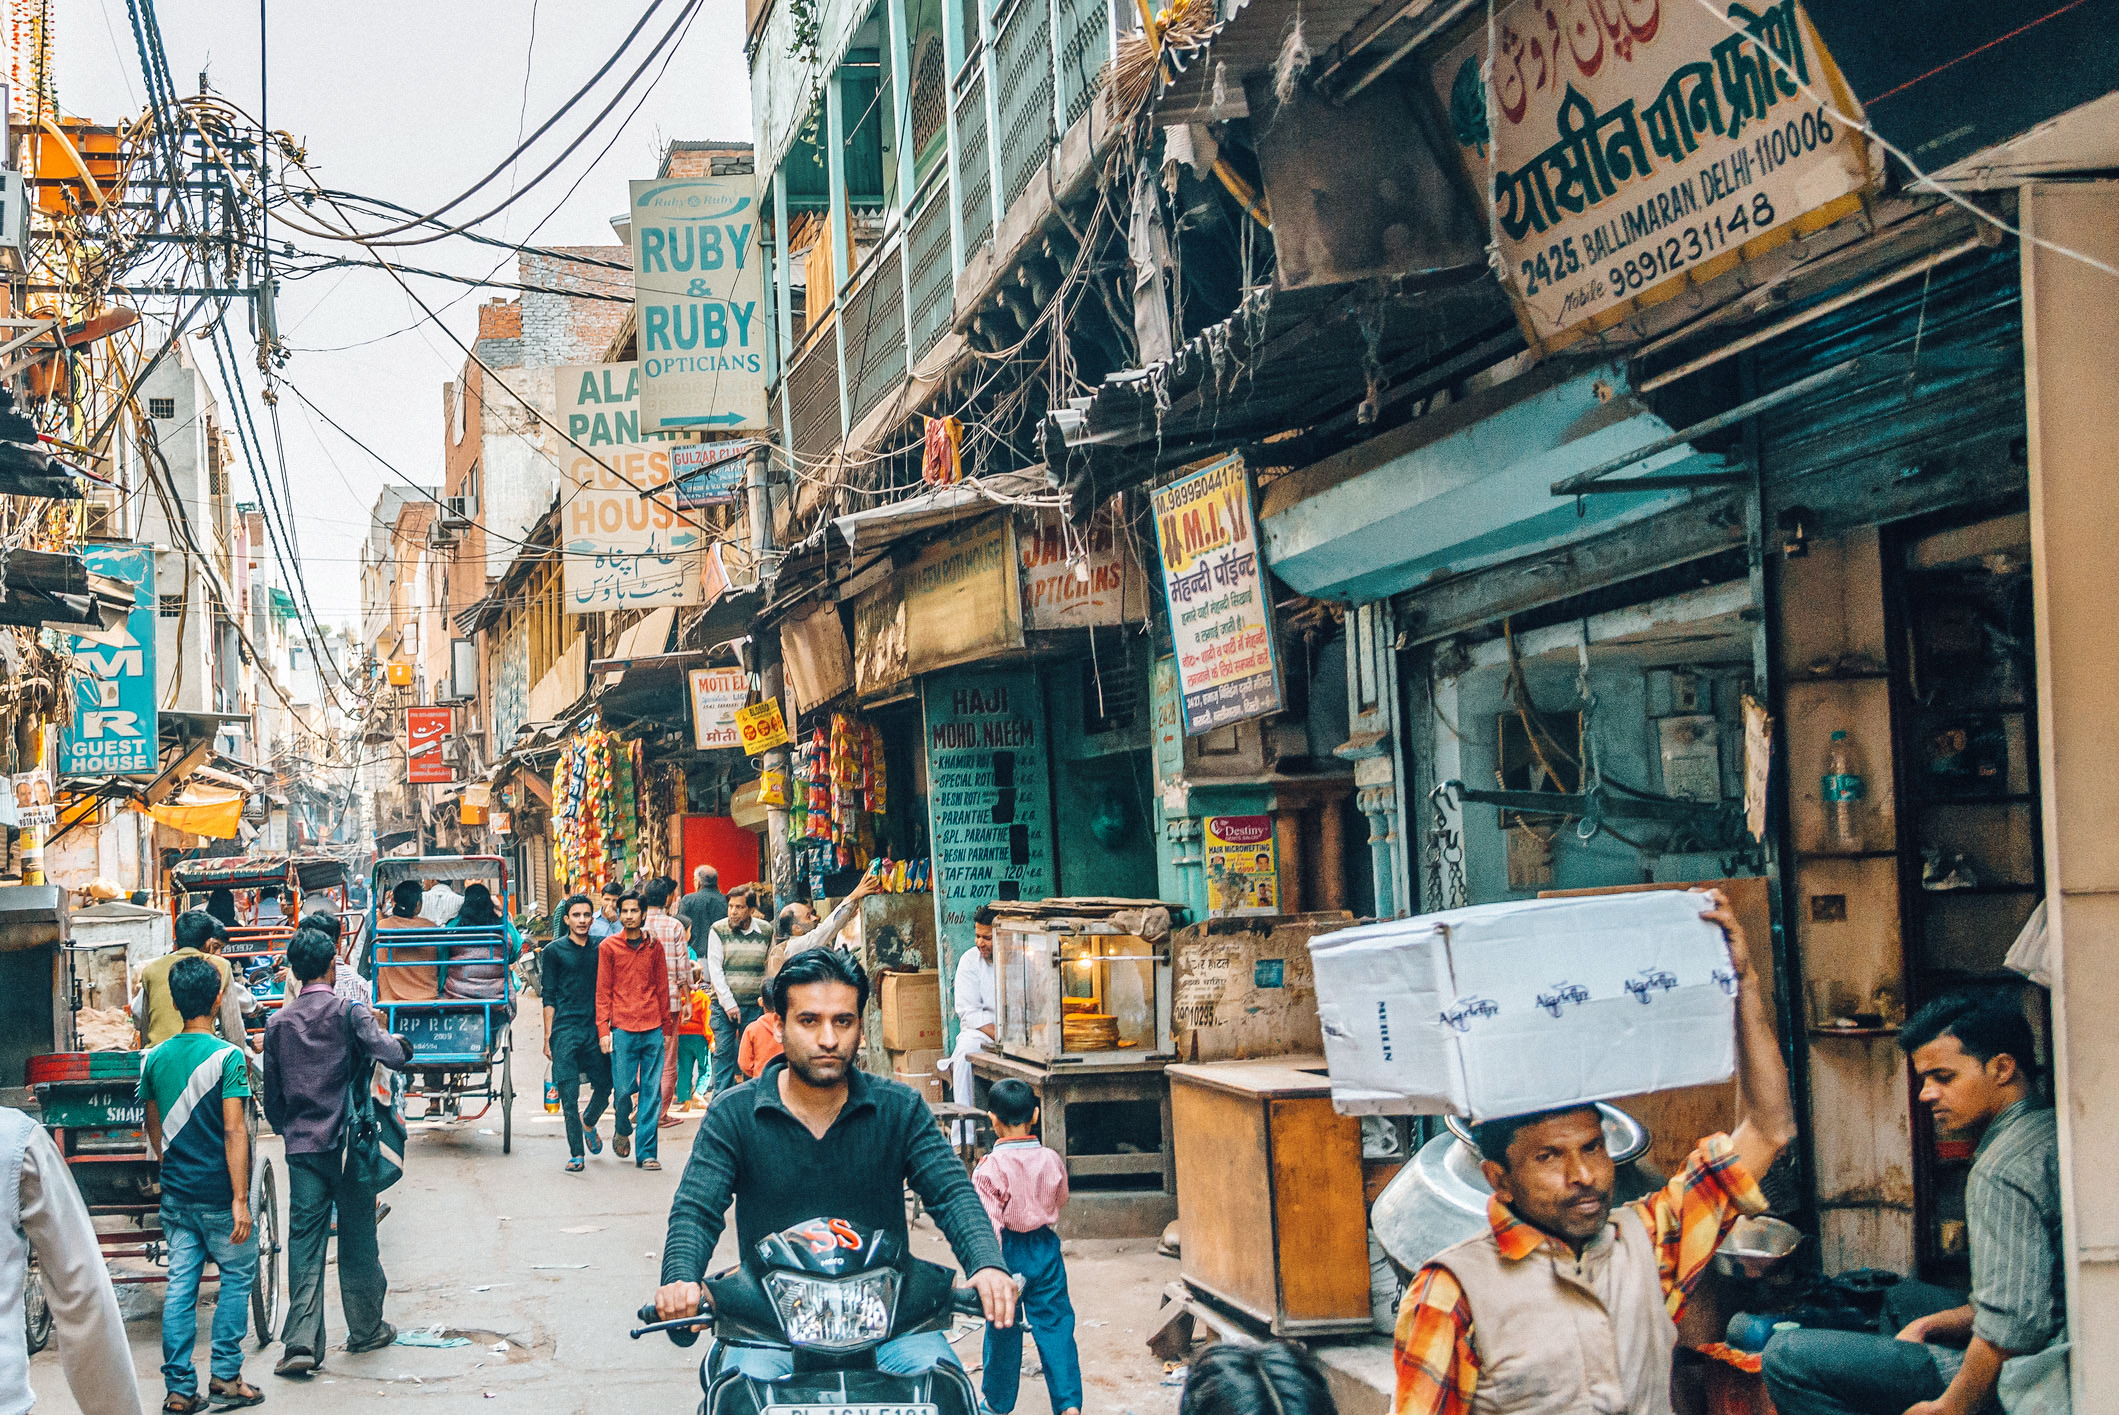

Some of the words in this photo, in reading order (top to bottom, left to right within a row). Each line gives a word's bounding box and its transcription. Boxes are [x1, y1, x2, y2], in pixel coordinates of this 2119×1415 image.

[1496, 81, 1652, 241] यासीन
[703, 194, 734, 206] Ruby
[1521, 236, 1585, 297] 2425,
[1699, 103, 1834, 202] DELHI-110006
[640, 223, 752, 274] RUBY
[1609, 192, 1776, 297] 9891231148
[686, 278, 713, 298] &
[645, 301, 756, 352] RUBY
[645, 353, 761, 378] OPTICIANS
[577, 368, 638, 405] ALA
[569, 410, 691, 447] PAN
[674, 450, 717, 466] GULZAR
[719, 446, 748, 462] CLIN
[570, 452, 669, 490] GUES
[1182, 501, 1226, 553] M.I.
[1169, 560, 1213, 603] मेहन्दी
[698, 677, 729, 693] MOTI
[732, 674, 748, 692] EL
[953, 687, 1009, 715] HAJI
[706, 728, 737, 743] मोती
[933, 721, 980, 750] MOHD.
[983, 719, 1035, 749] NAEEM
[71, 739, 147, 757] GUEST
[71, 755, 147, 772] HOUSE
[939, 755, 976, 769] KHAMIRI
[940, 773, 972, 788] SPECIAL
[975, 772, 995, 787] ROTI
[964, 791, 980, 805] ROTI
[942, 809, 990, 825] PARANTHE
[964, 827, 1009, 843] PARANTHE
[1225, 824, 1265, 836] Destiny
[968, 847, 1009, 861] PARANTHE
[1209, 846, 1223, 854] HAIR
[946, 885, 967, 899] LAL
[970, 884, 994, 898] ROTI
[1376, 1001, 1393, 1061] MERLIN
[803, 1218, 864, 1255] SS
